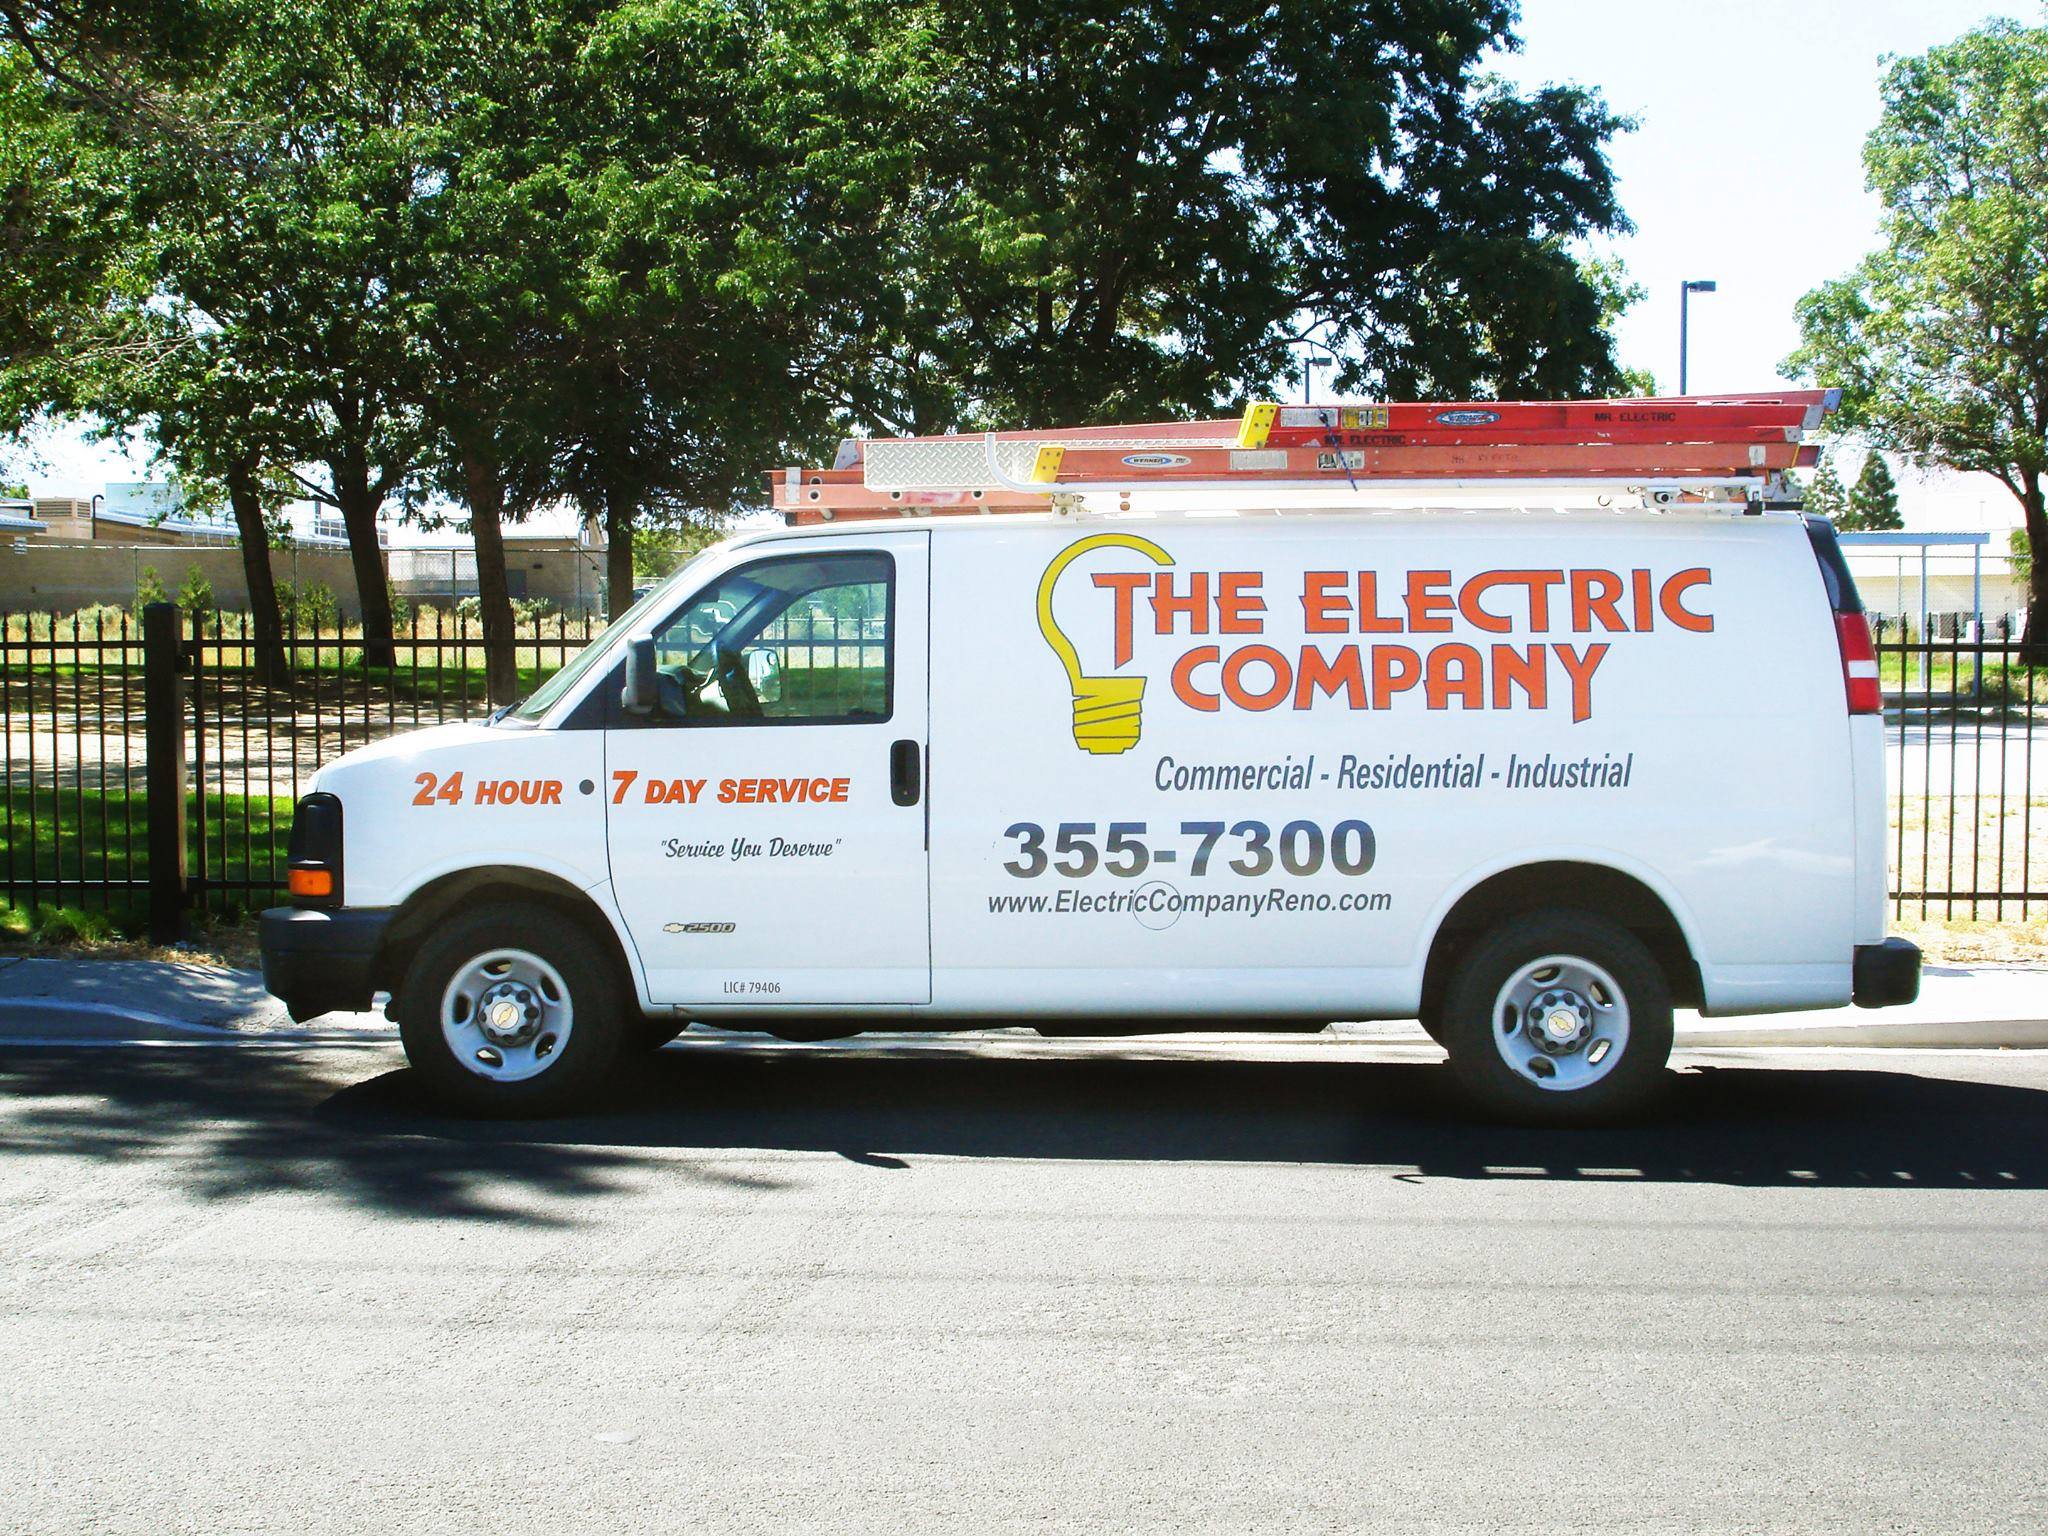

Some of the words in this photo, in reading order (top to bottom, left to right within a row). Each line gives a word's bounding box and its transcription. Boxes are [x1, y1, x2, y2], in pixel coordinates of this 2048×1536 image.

[1594, 412, 1611, 422] MR
[1620, 412, 1676, 422] ELECTRIC
[1350, 434, 1406, 447] ELECTRIC
[1132, 456, 1164, 464] WERNER
[1090, 570, 1268, 670] THE
[1298, 567, 1714, 634] ELECTRIC
[1171, 642, 1611, 724] COMPANY
[1155, 755, 1315, 792] Commercial
[1337, 754, 1485, 790] Residential
[1506, 752, 1633, 789] Industrial
[411, 771, 464, 807] 24
[474, 779, 563, 806] HOUR
[612, 770, 639, 805] 7
[644, 778, 708, 805] DAY
[717, 777, 851, 804] SERVICE
[660, 838, 725, 859] "Service
[730, 837, 763, 862] You
[769, 837, 842, 858] Deserve"
[1002, 820, 1378, 879] 355-7300
[987, 888, 1392, 918] www.ElectricCompanyReno.com
[686, 922, 736, 934] 2500
[723, 981, 746, 994] LIC#
[748, 981, 781, 994] 79406
